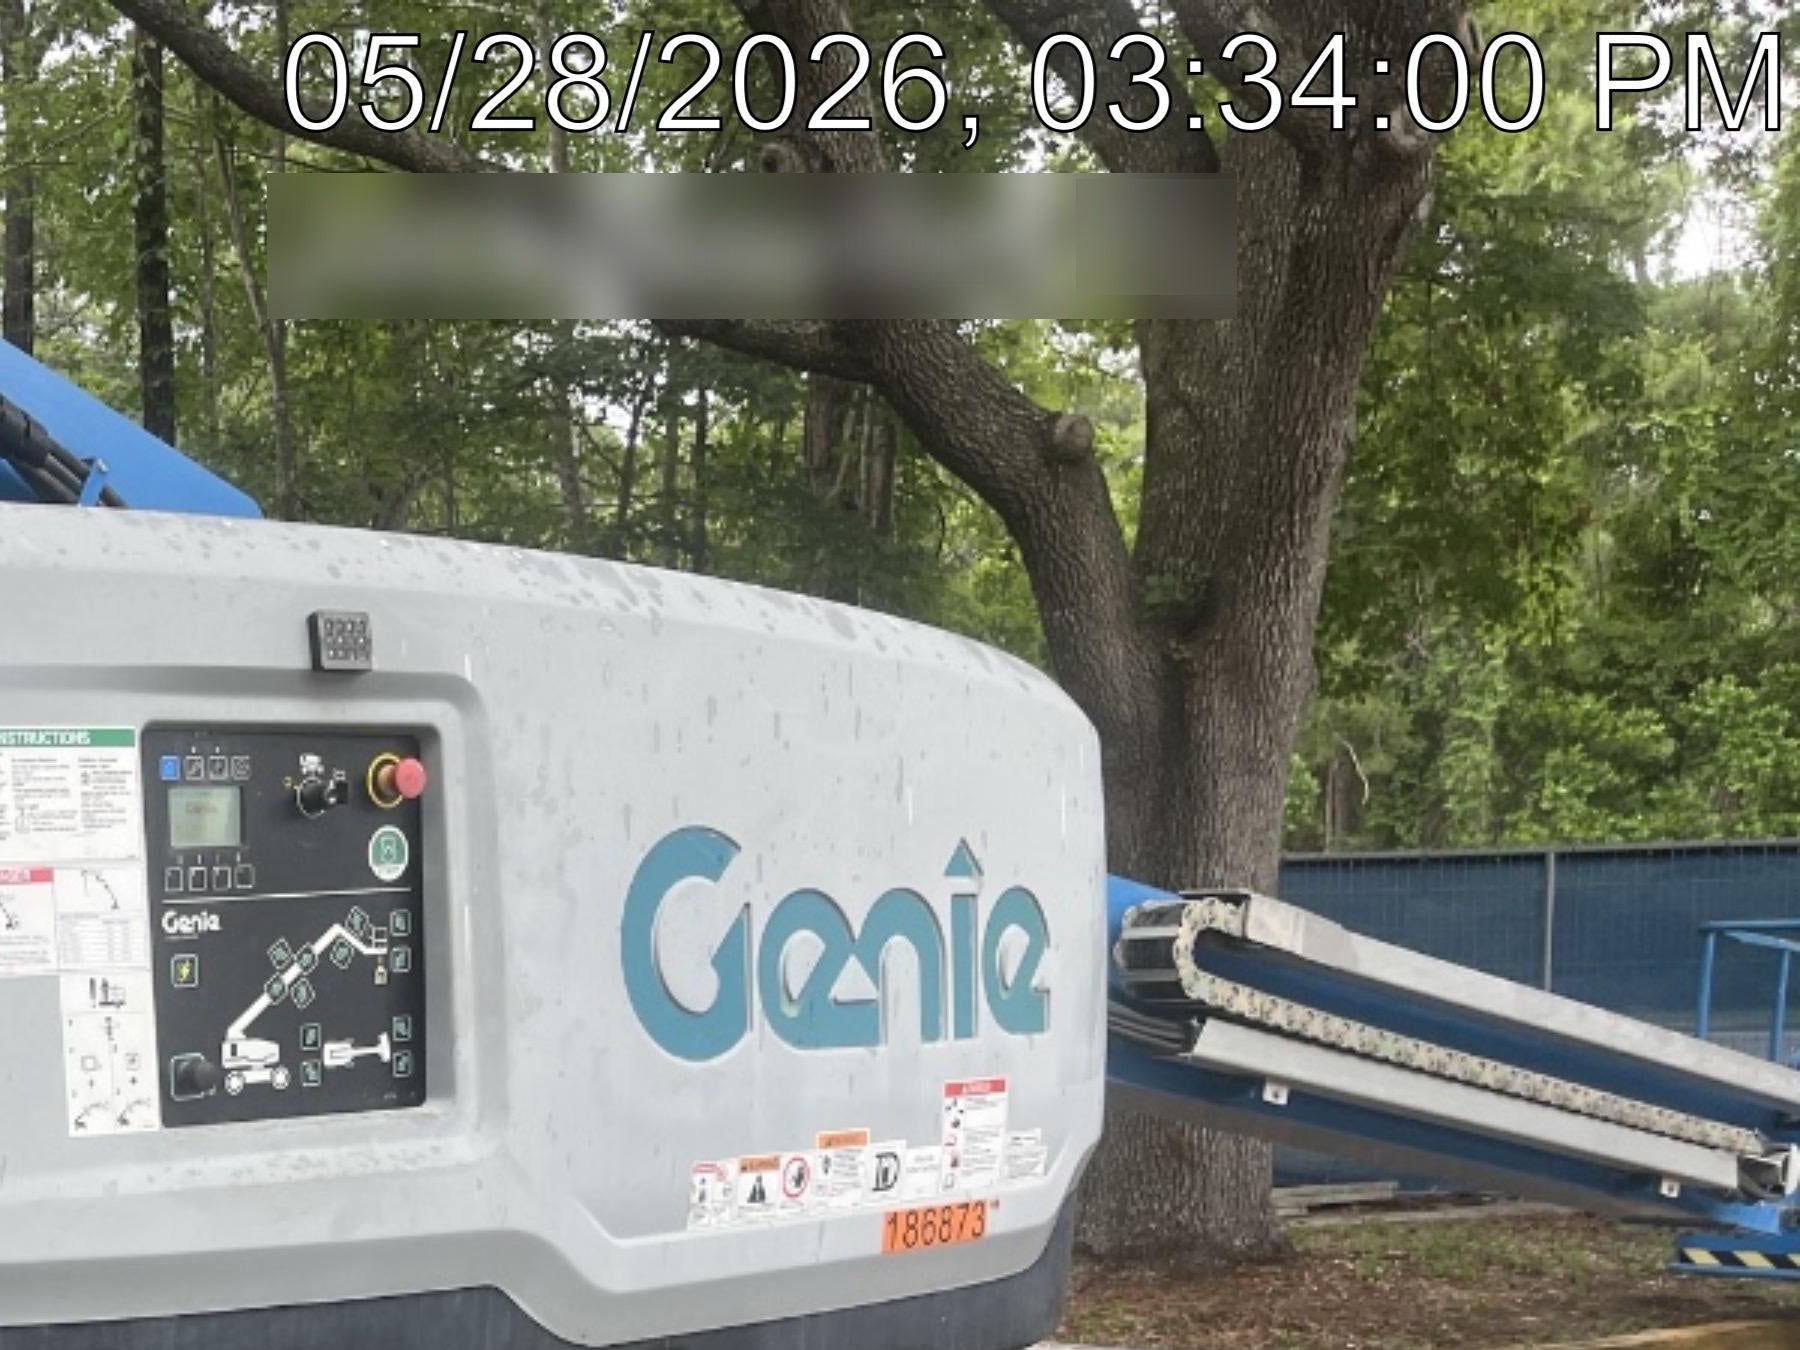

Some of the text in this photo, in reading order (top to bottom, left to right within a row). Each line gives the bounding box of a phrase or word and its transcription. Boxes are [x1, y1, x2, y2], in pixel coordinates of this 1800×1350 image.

[162, 908, 221, 933] Genie
[620, 825, 1051, 1062] Genie
[887, 1200, 985, 1250] 186873
